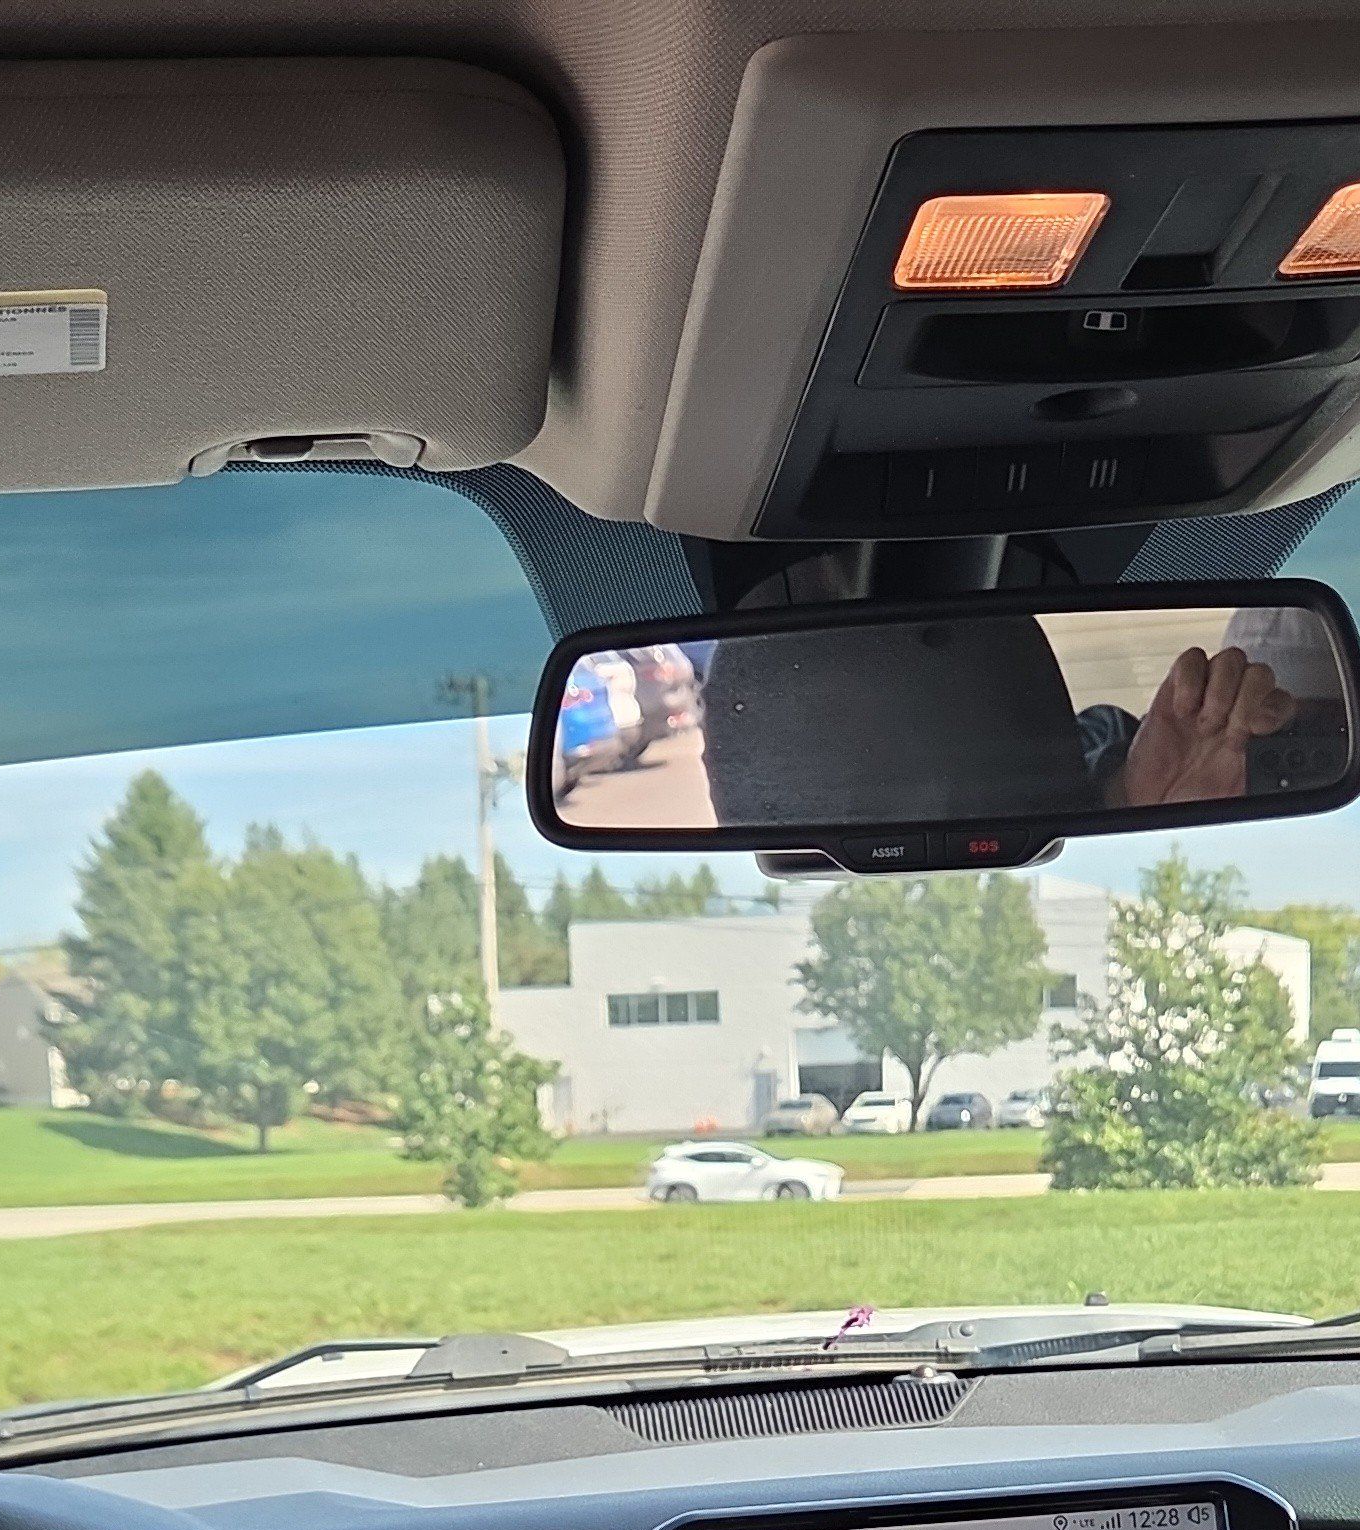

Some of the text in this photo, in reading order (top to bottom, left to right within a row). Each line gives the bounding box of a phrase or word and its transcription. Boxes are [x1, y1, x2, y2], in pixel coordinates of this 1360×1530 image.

[871, 846, 905, 859] ASSIST
[968, 840, 1000, 854] SOS
[1128, 1507, 1180, 1529] 12:28
